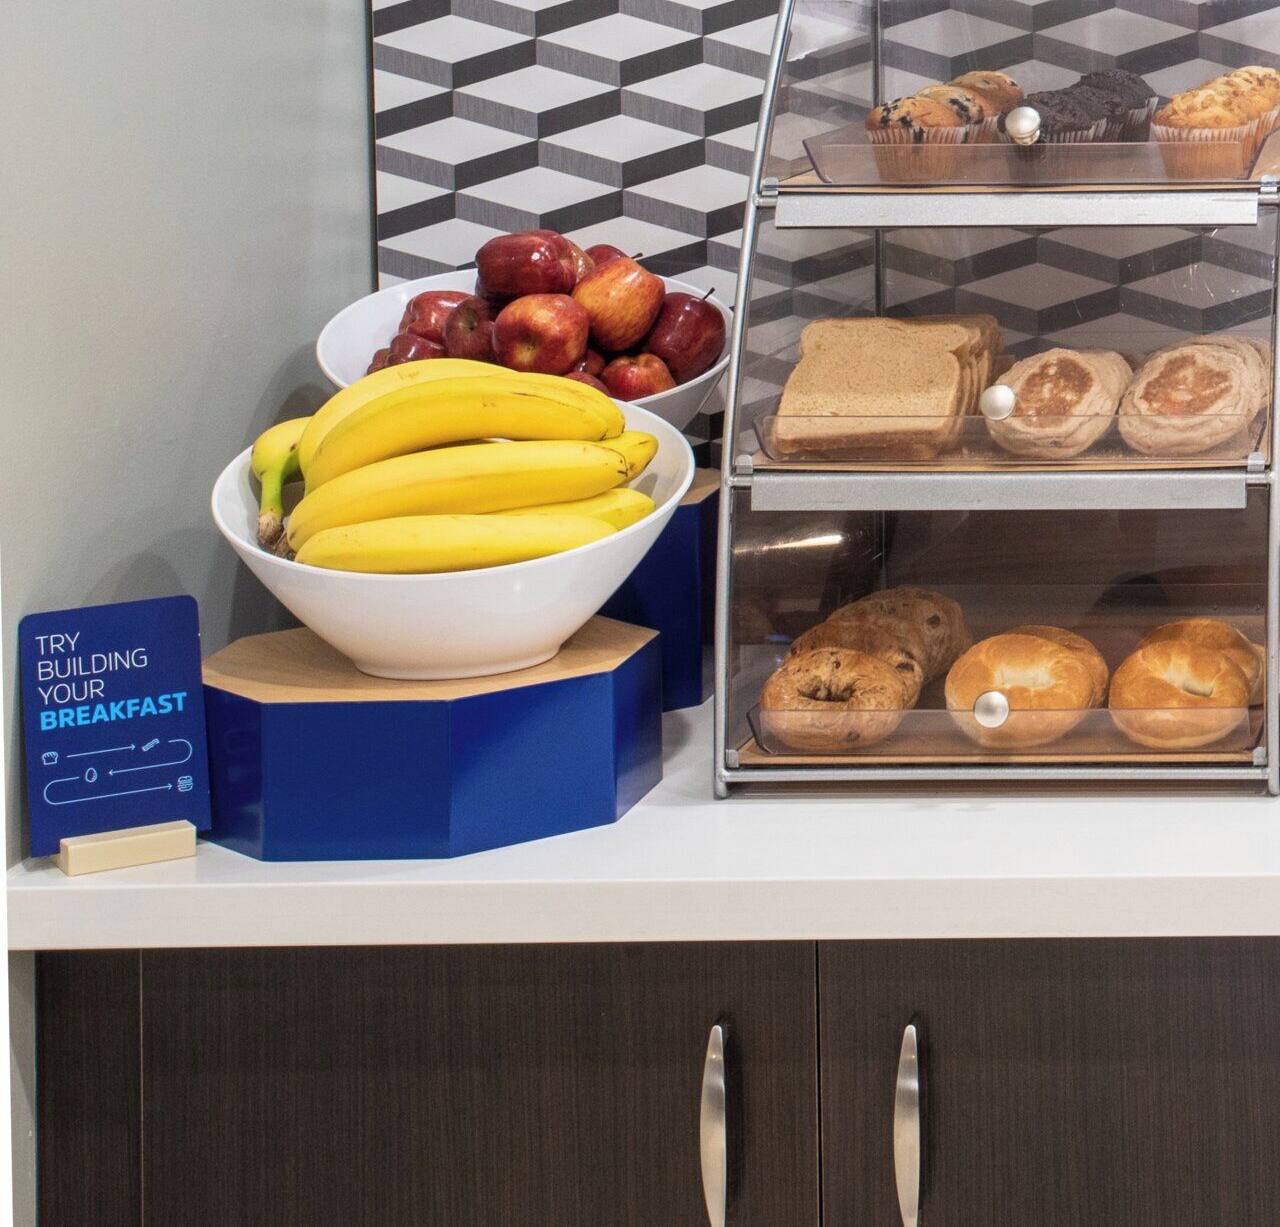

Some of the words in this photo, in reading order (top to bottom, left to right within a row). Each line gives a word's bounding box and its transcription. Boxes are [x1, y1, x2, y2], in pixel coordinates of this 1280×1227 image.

[35, 631, 81, 656] TRY
[37, 647, 148, 682] BUILDING
[38, 679, 105, 706] YOUR
[40, 691, 188, 731] BREAKFAST
